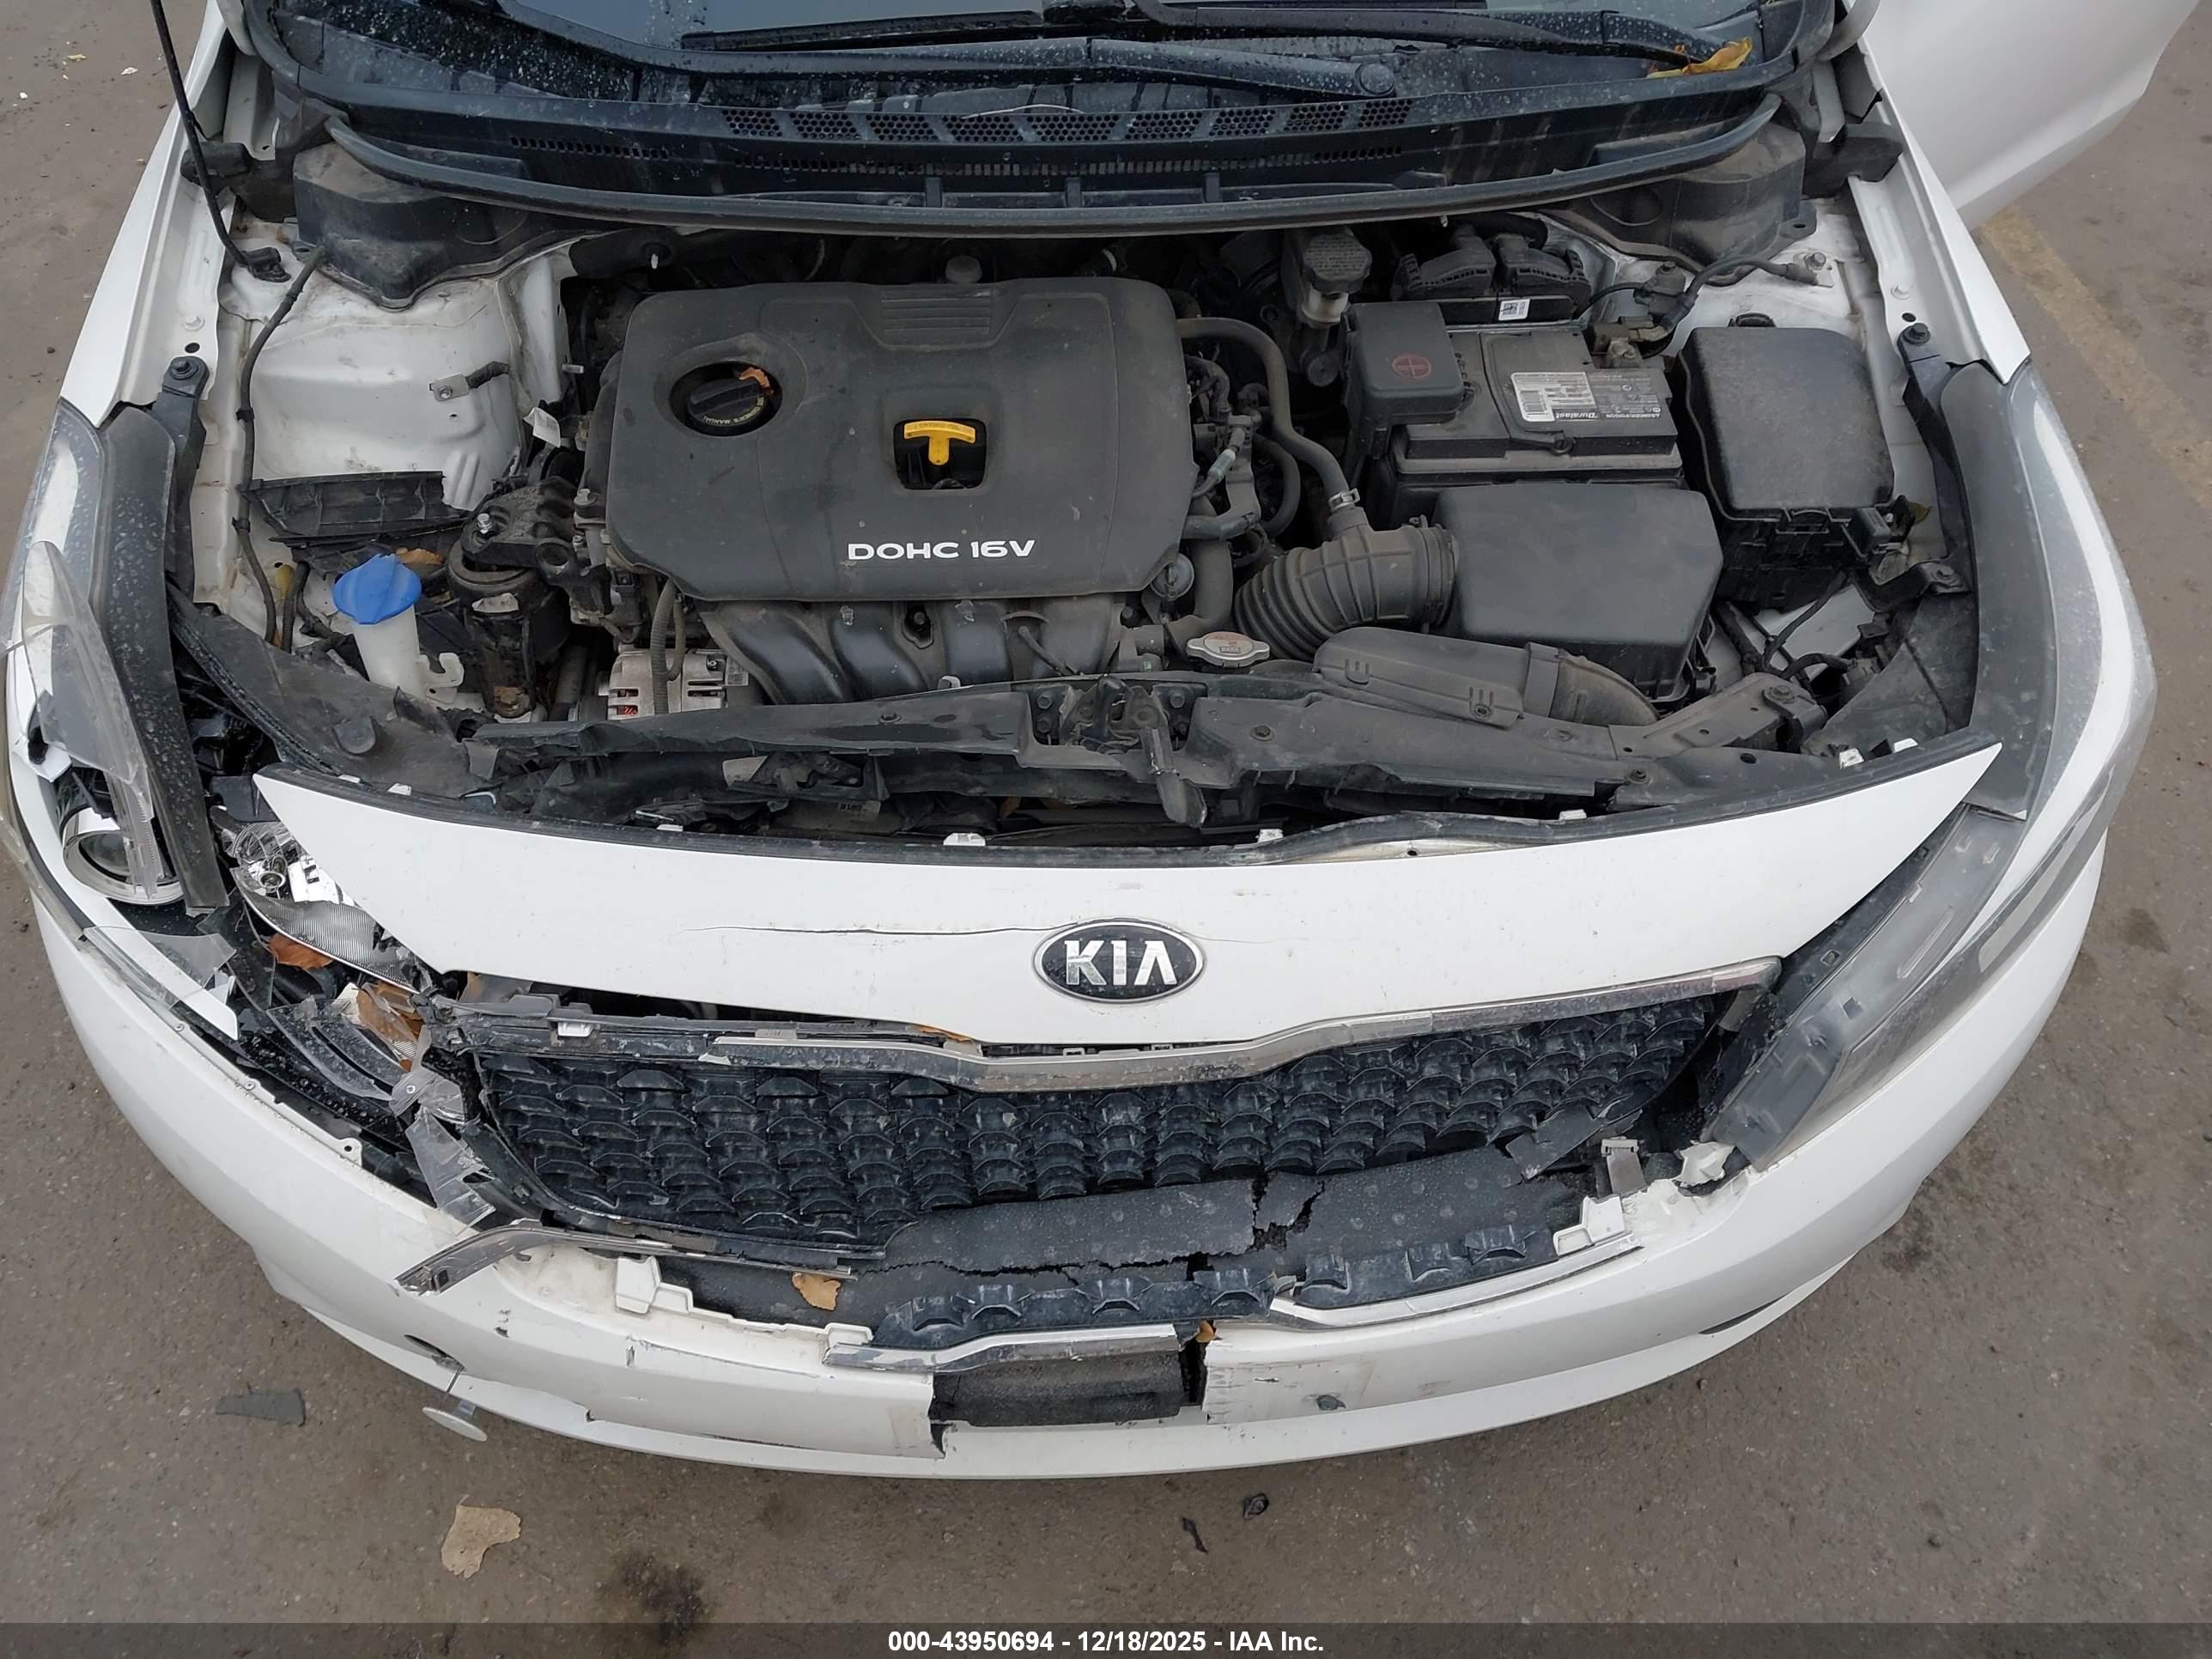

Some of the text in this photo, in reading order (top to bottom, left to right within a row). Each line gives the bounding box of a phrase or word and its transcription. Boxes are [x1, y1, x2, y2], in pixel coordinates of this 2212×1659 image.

[702, 416, 731, 425] MANUAL
[848, 539, 1035, 560] DOHC 16V
[1064, 940, 1177, 986] KIA
